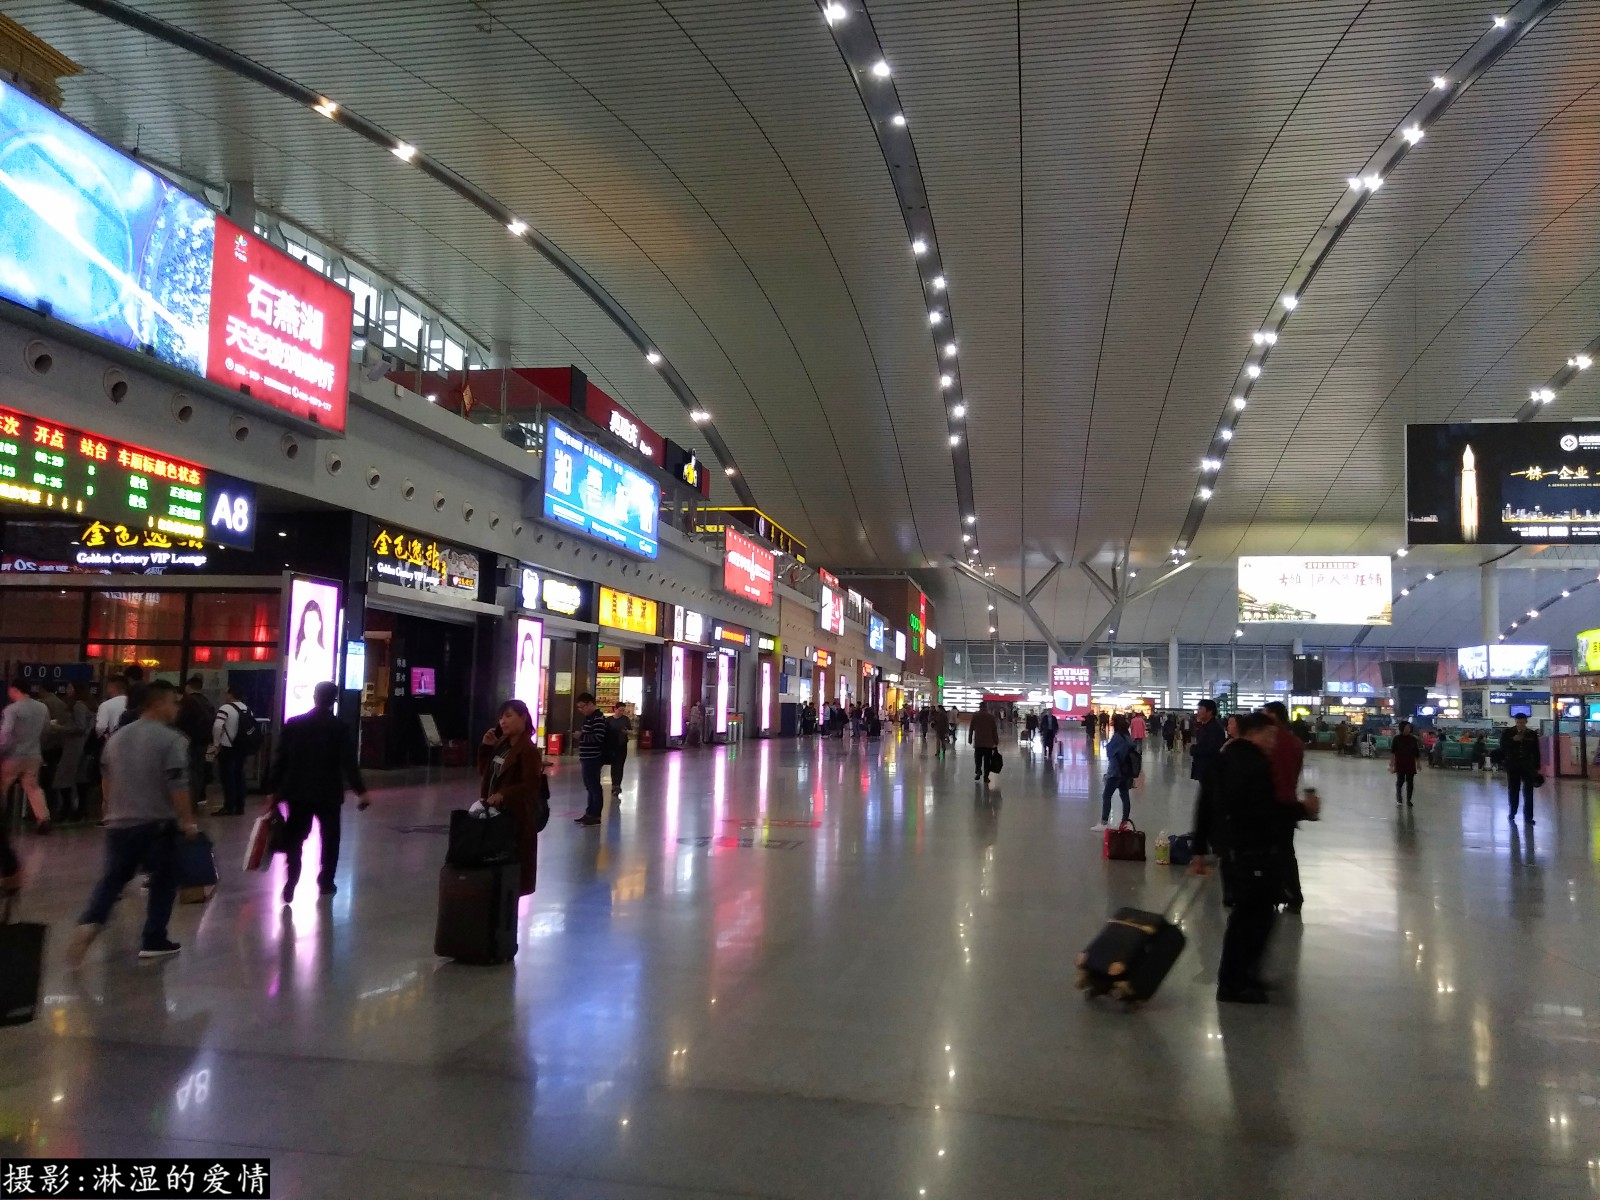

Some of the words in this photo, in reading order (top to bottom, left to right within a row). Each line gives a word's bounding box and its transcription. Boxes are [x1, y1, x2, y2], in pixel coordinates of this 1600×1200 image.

[247, 274, 324, 350] 石燕湖
[34, 425, 64, 449] 开点
[80, 437, 108, 461] 站台
[212, 492, 248, 532] A8
[76, 552, 111, 564] Golden
[112, 552, 149, 566] Century
[151, 552, 170, 564] VIP
[172, 553, 206, 567] Lounge
[377, 562, 395, 575] Golden
[1053, 668, 1089, 676] annwa
